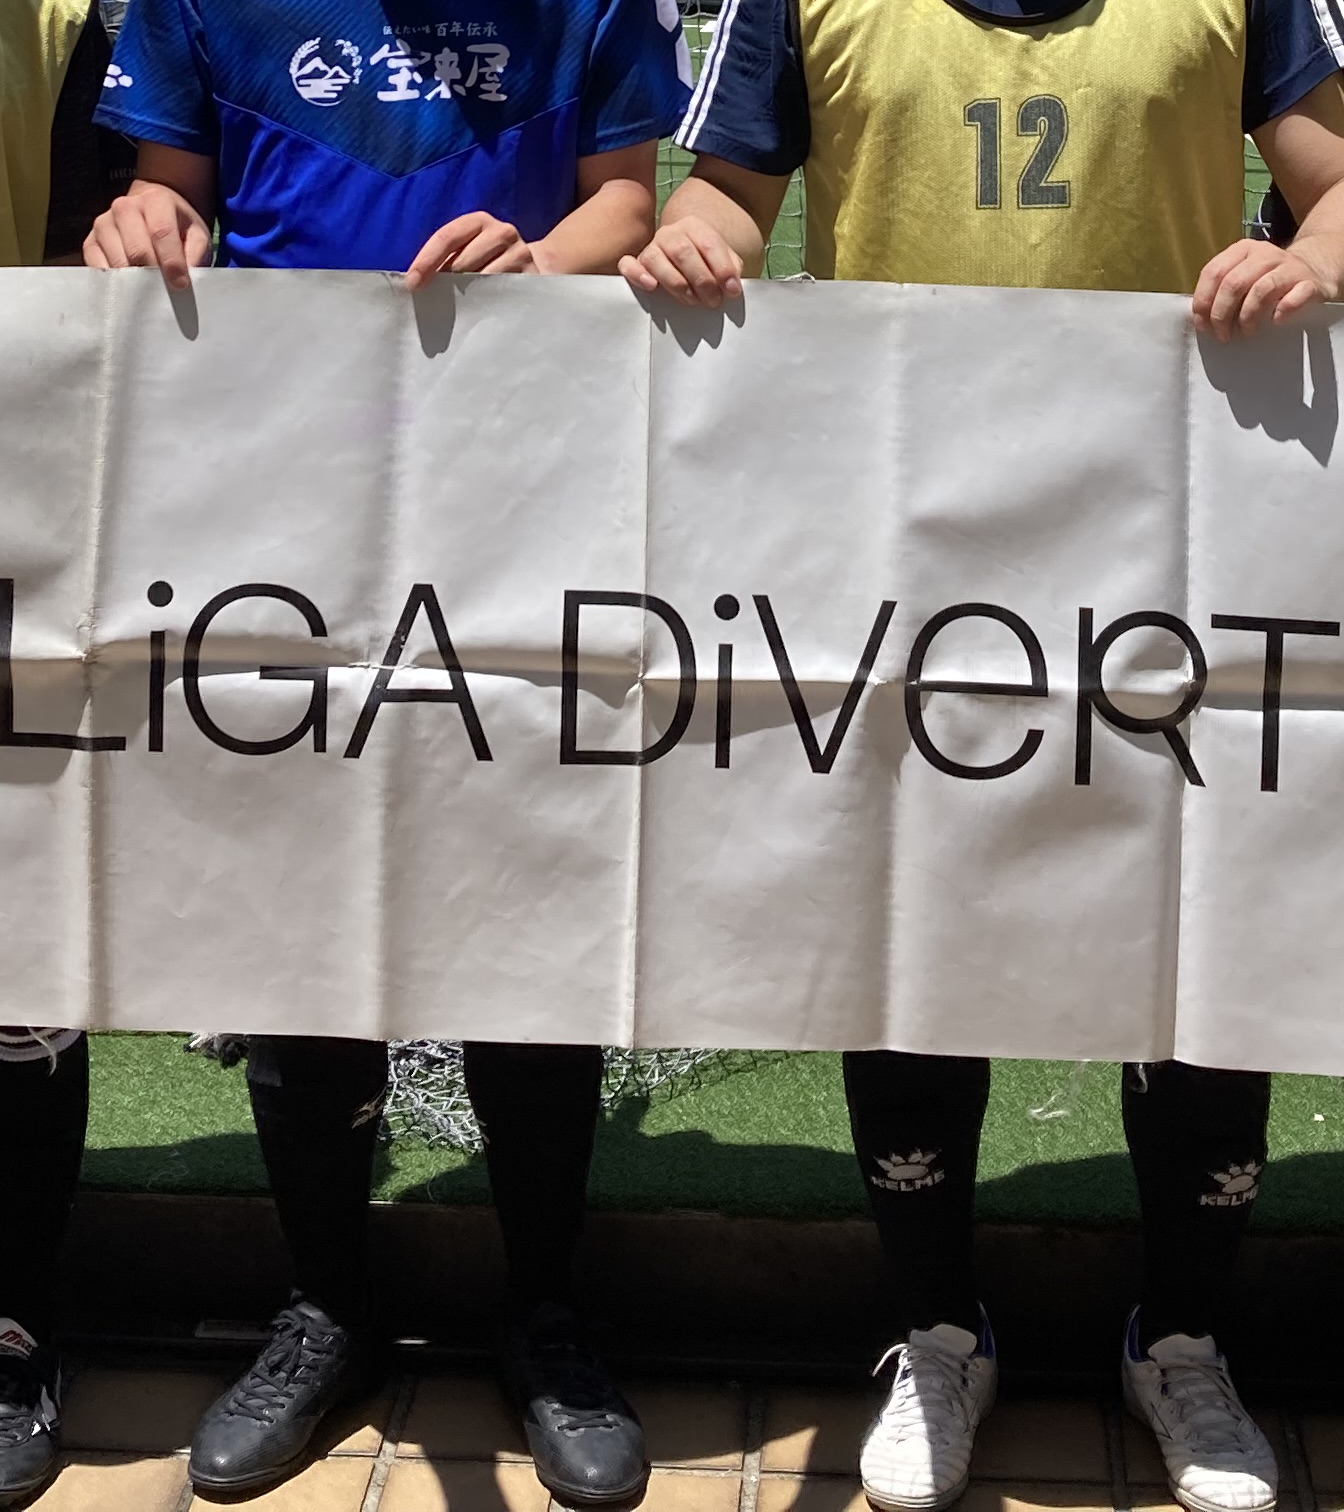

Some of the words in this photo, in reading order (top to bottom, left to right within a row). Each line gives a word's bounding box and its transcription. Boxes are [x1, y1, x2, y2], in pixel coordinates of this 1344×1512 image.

[434, 21, 499, 37] 百年伝承
[369, 38, 511, 102] 宝来屋
[963, 93, 1072, 211] 12
[1199, 1184, 1260, 1206] KELM
